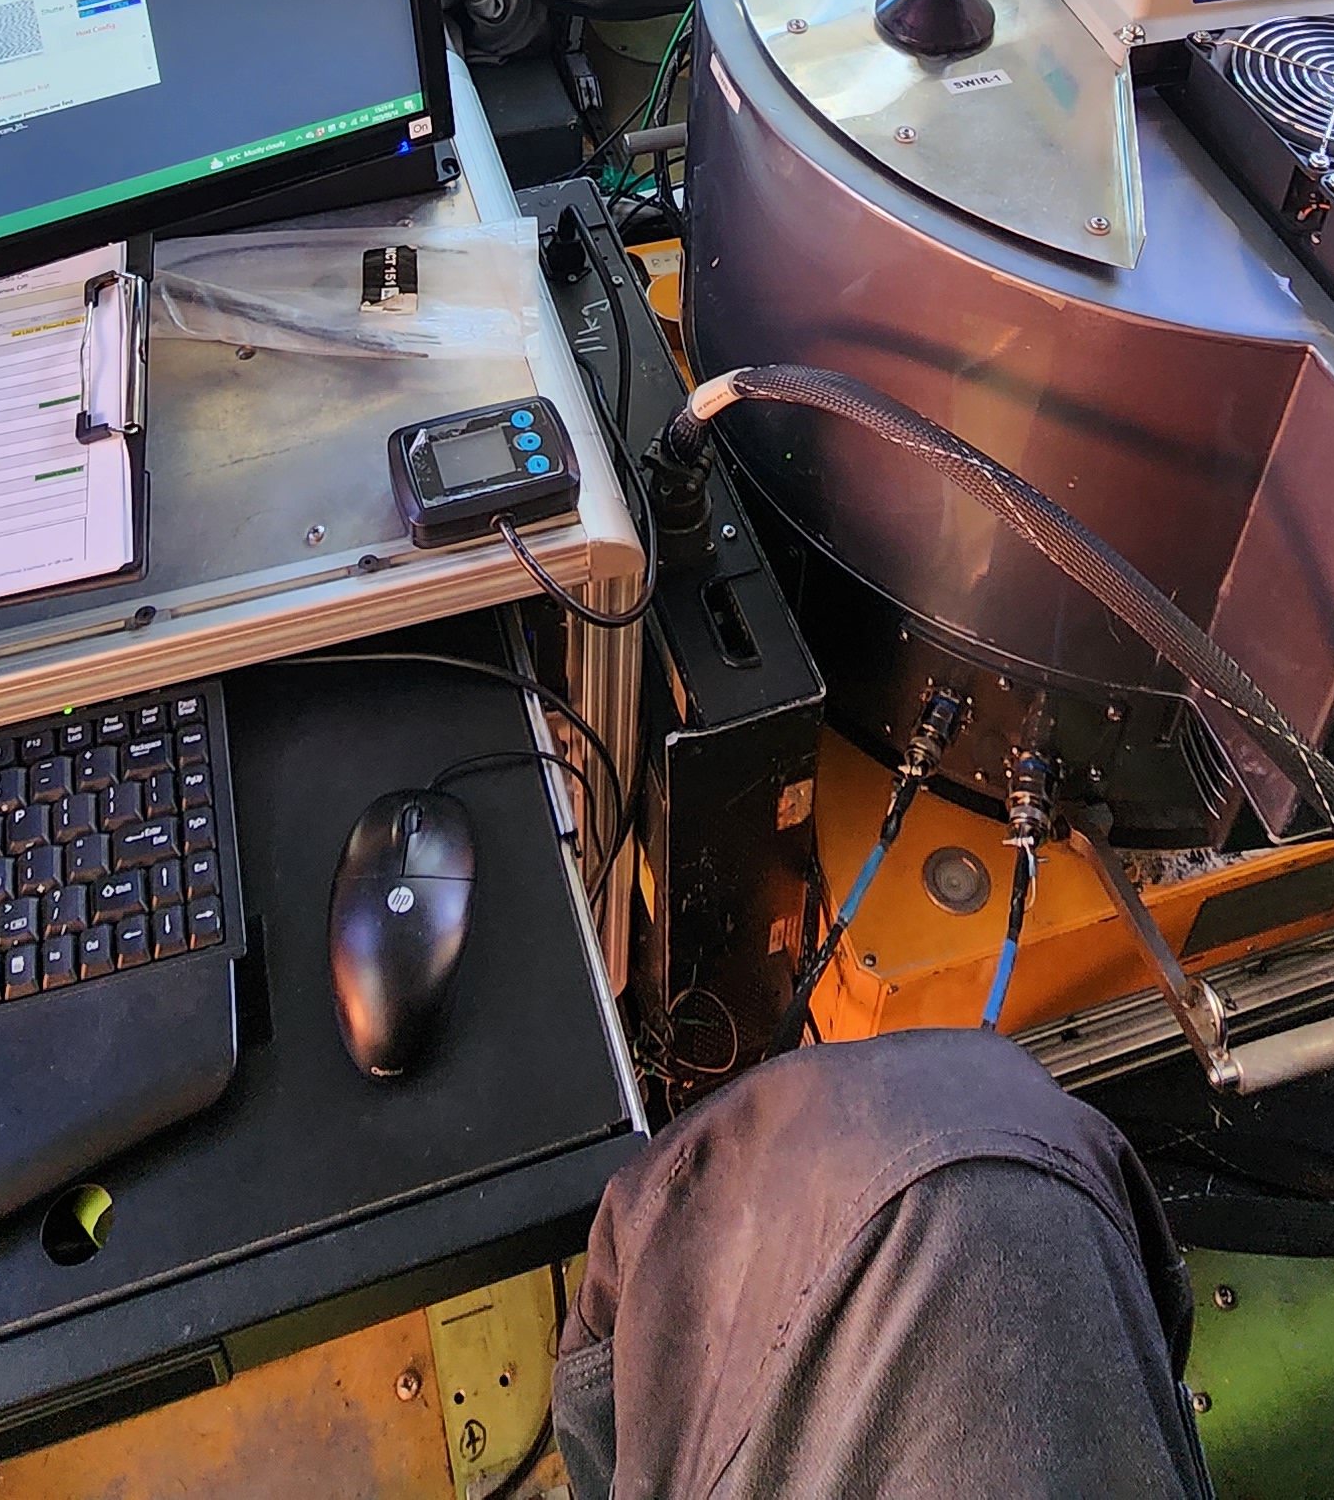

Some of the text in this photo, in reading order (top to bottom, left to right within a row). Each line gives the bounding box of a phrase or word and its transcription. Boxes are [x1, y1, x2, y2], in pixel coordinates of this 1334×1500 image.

[953, 74, 1001, 90] SWIR-1
[413, 123, 428, 134] On
[384, 269, 397, 287] 151
[26, 739, 41, 748] F12
[15, 810, 25, 823] P
